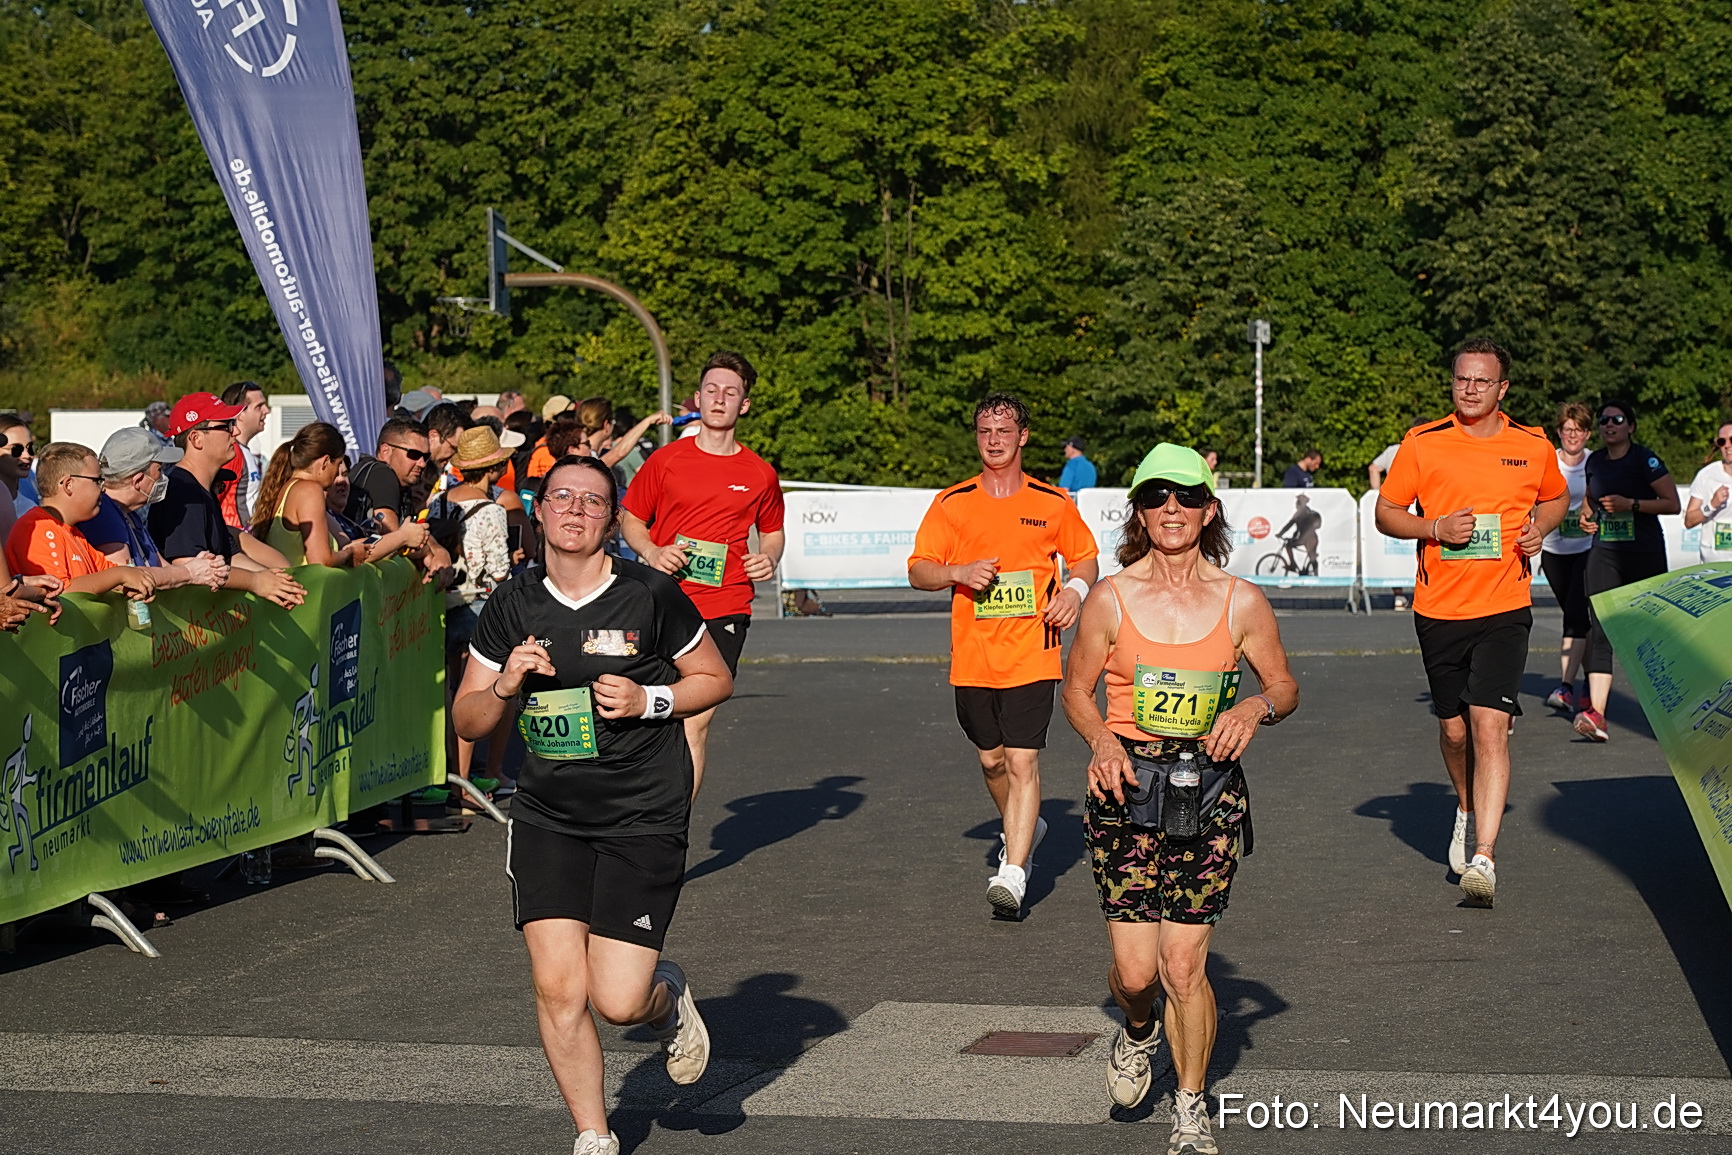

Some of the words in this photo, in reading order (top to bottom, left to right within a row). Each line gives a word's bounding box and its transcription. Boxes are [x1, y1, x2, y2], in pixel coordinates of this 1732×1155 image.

[1501, 459, 1527, 467] THULE
[802, 511, 837, 523] NOW
[1020, 517, 1047, 528] THULE
[806, 533, 858, 546] E-BIKES
[1471, 529, 1491, 544] 94
[984, 587, 1025, 603] 1410
[71, 679, 102, 707] Fischer
[1137, 691, 1145, 722] WALK
[1153, 691, 1198, 716] 271
[1204, 698, 1215, 727] 2022
[530, 715, 569, 737] 420
[1149, 713, 1178, 724] Hilbich
[1180, 717, 1201, 727] Lydia
[579, 716, 592, 749] 2022
[547, 740, 580, 748] Johanna
[36, 715, 153, 832] firmenlauf
[43, 814, 91, 860] neumarkt
